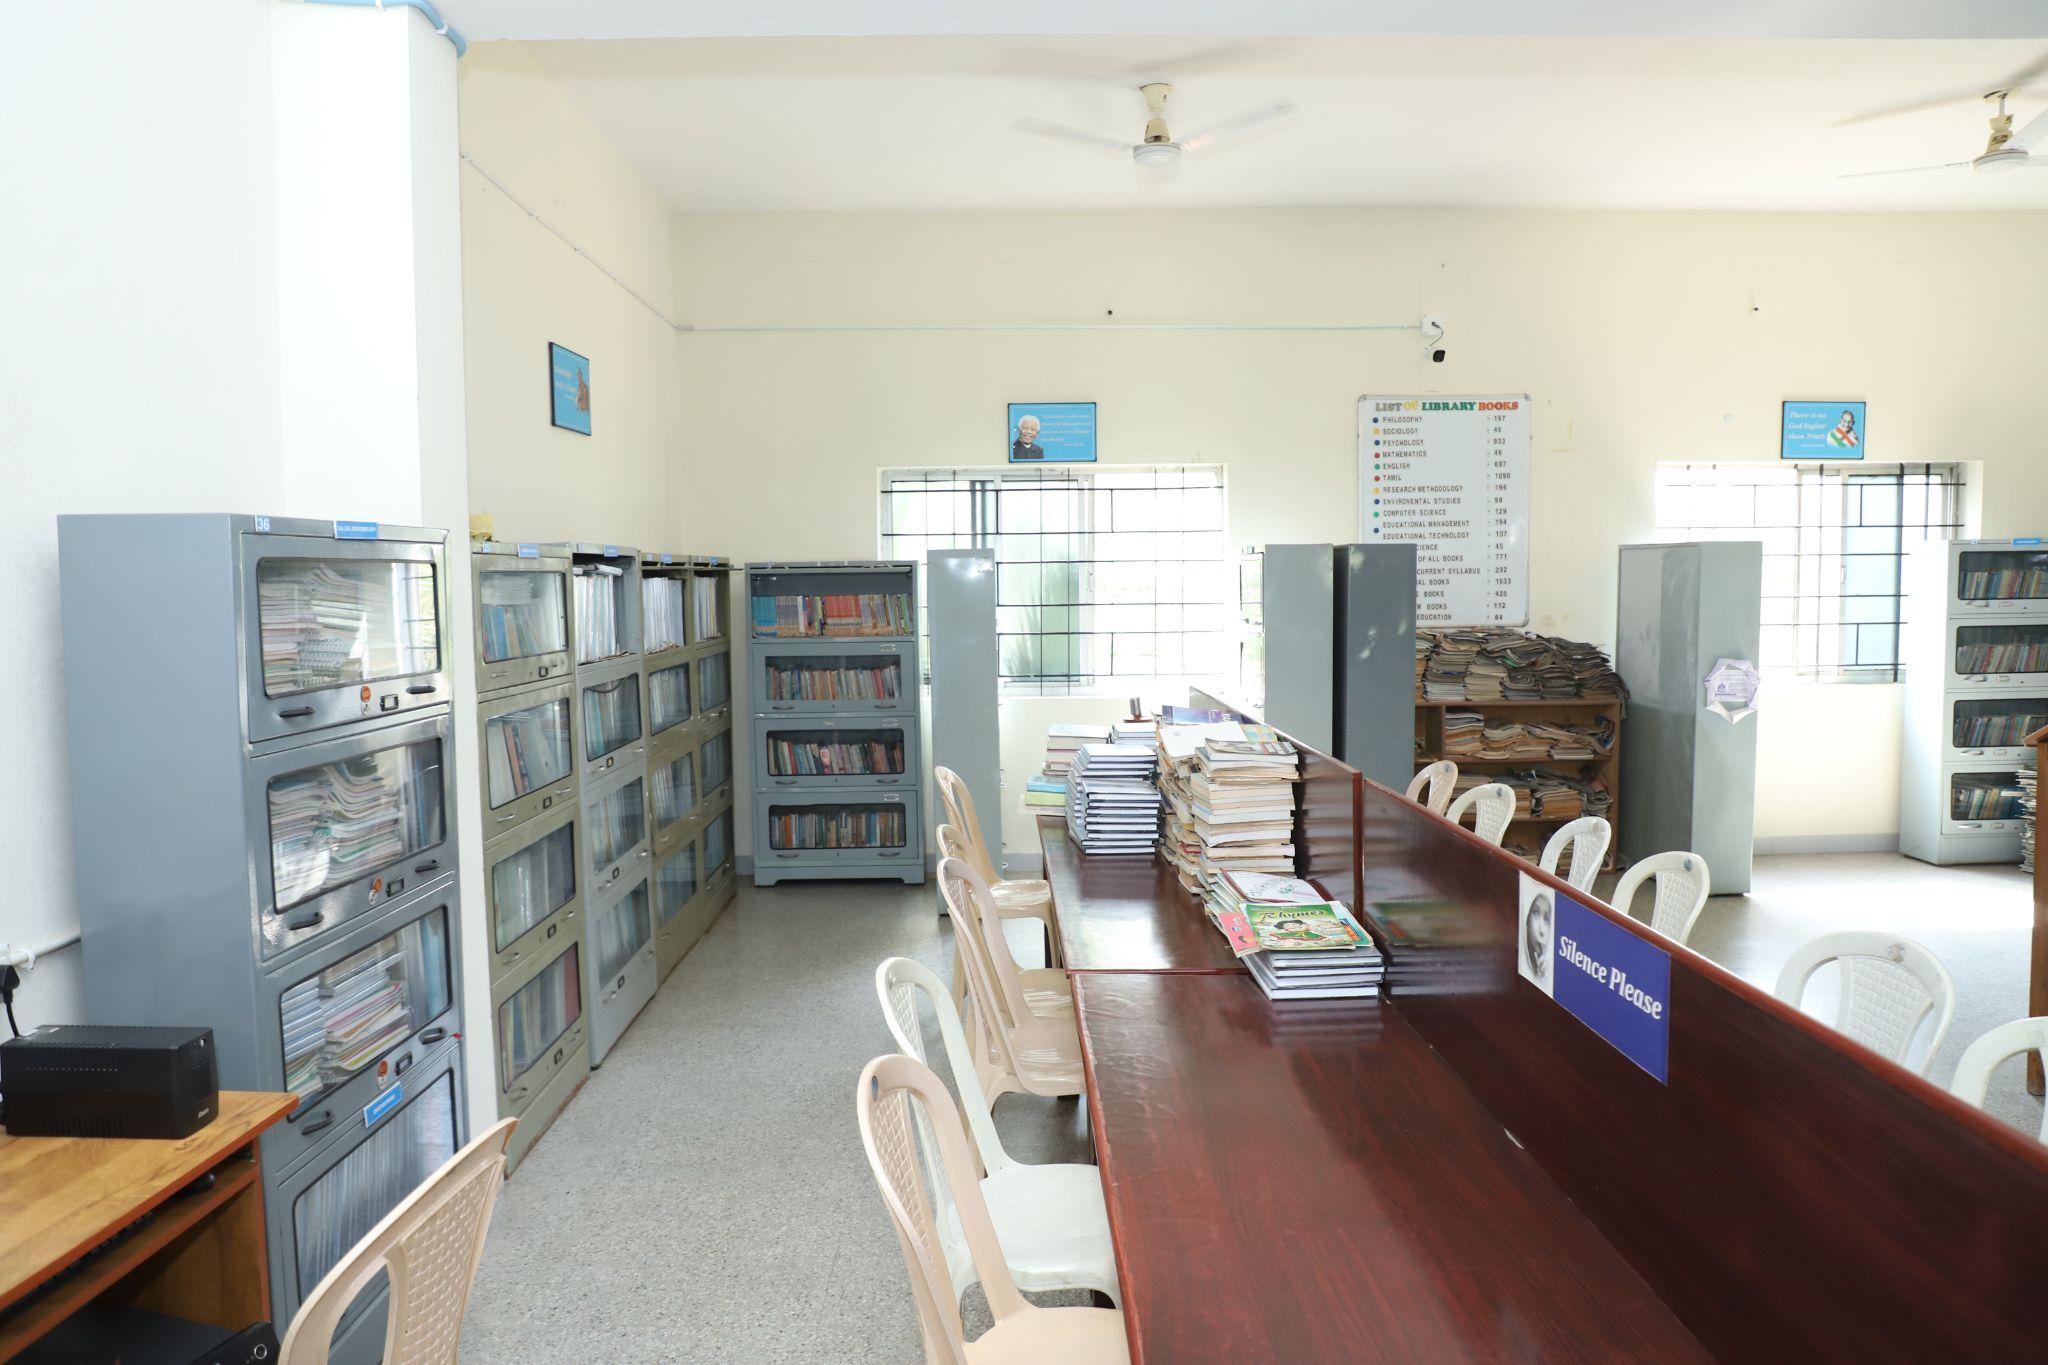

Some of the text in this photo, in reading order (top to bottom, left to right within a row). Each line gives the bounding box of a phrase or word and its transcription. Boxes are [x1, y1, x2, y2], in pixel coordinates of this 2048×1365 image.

[1375, 401, 1519, 412] LIST OF LIBRARY BOOKS
[1417, 485, 1463, 493] METHODOLOGY
[1420, 508, 1447, 516] SCIENCE
[257, 518, 270, 530] 36
[1383, 532, 1426, 540] EDUCATIONAL
[1447, 567, 1481, 575] SYLLABUS
[1428, 578, 1450, 586] BOOKS
[1423, 590, 1445, 598] BOOKS
[1258, 910, 1324, 920] Rhymes
[1559, 935, 1663, 1020] Silence Please
